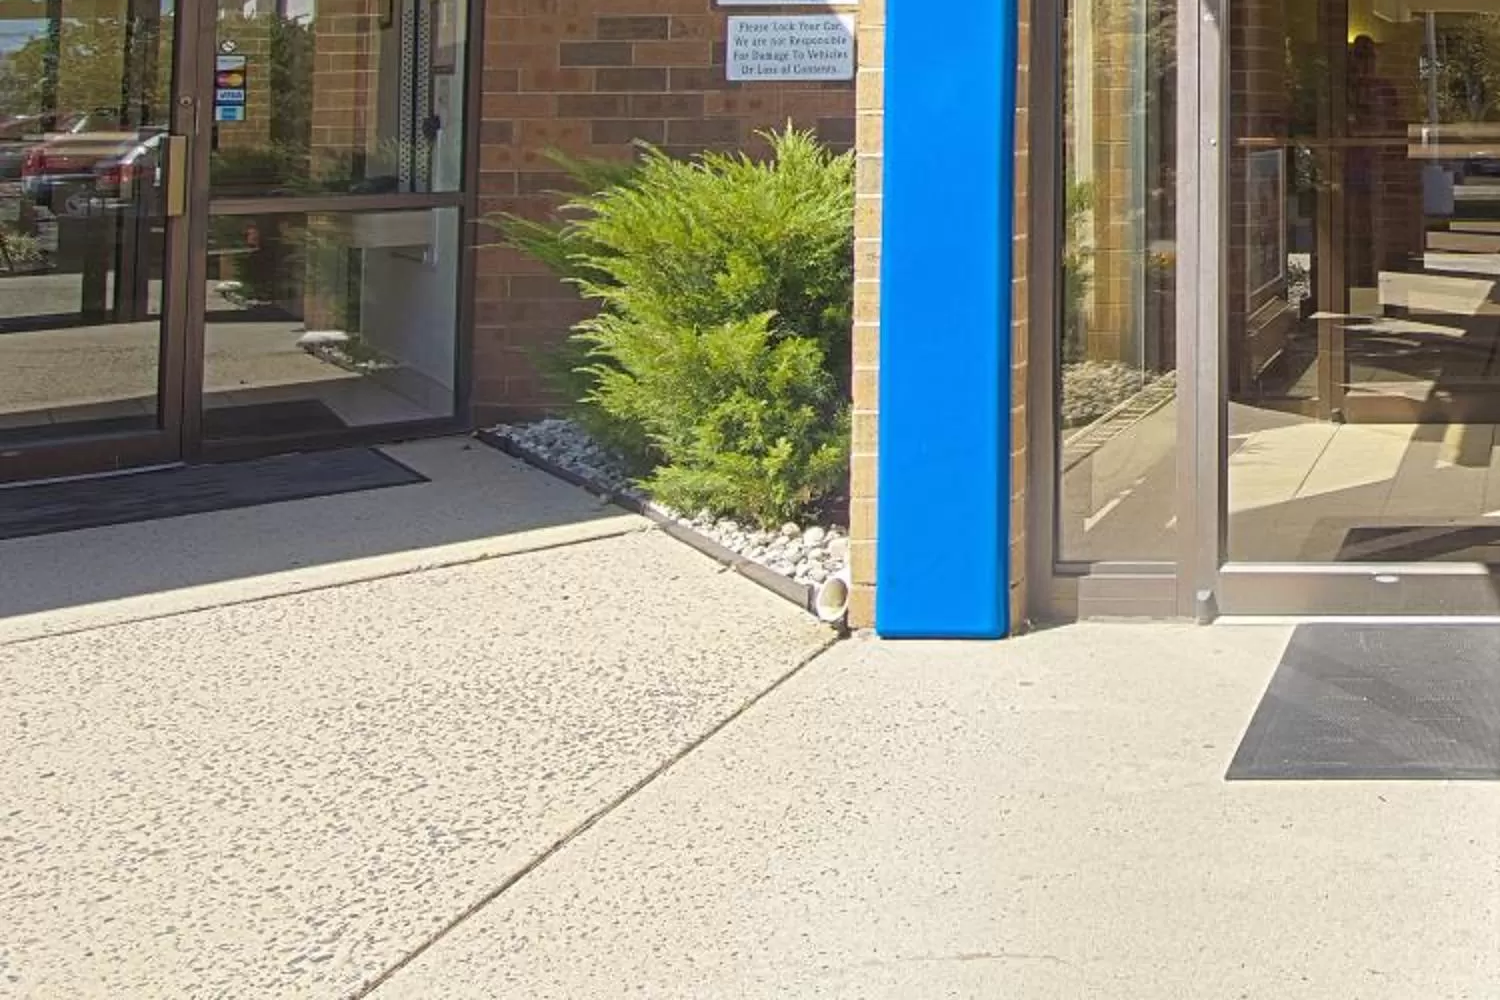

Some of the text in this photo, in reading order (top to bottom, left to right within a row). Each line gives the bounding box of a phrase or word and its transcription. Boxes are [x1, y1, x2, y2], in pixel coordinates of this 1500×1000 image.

[738, 21, 768, 33] Please
[772, 21, 795, 31] Lock
[799, 21, 821, 31] Your
[735, 35, 848, 47] We are not Responsible
[733, 49, 849, 62] For Damage To Vehicles
[741, 65, 754, 75] Or
